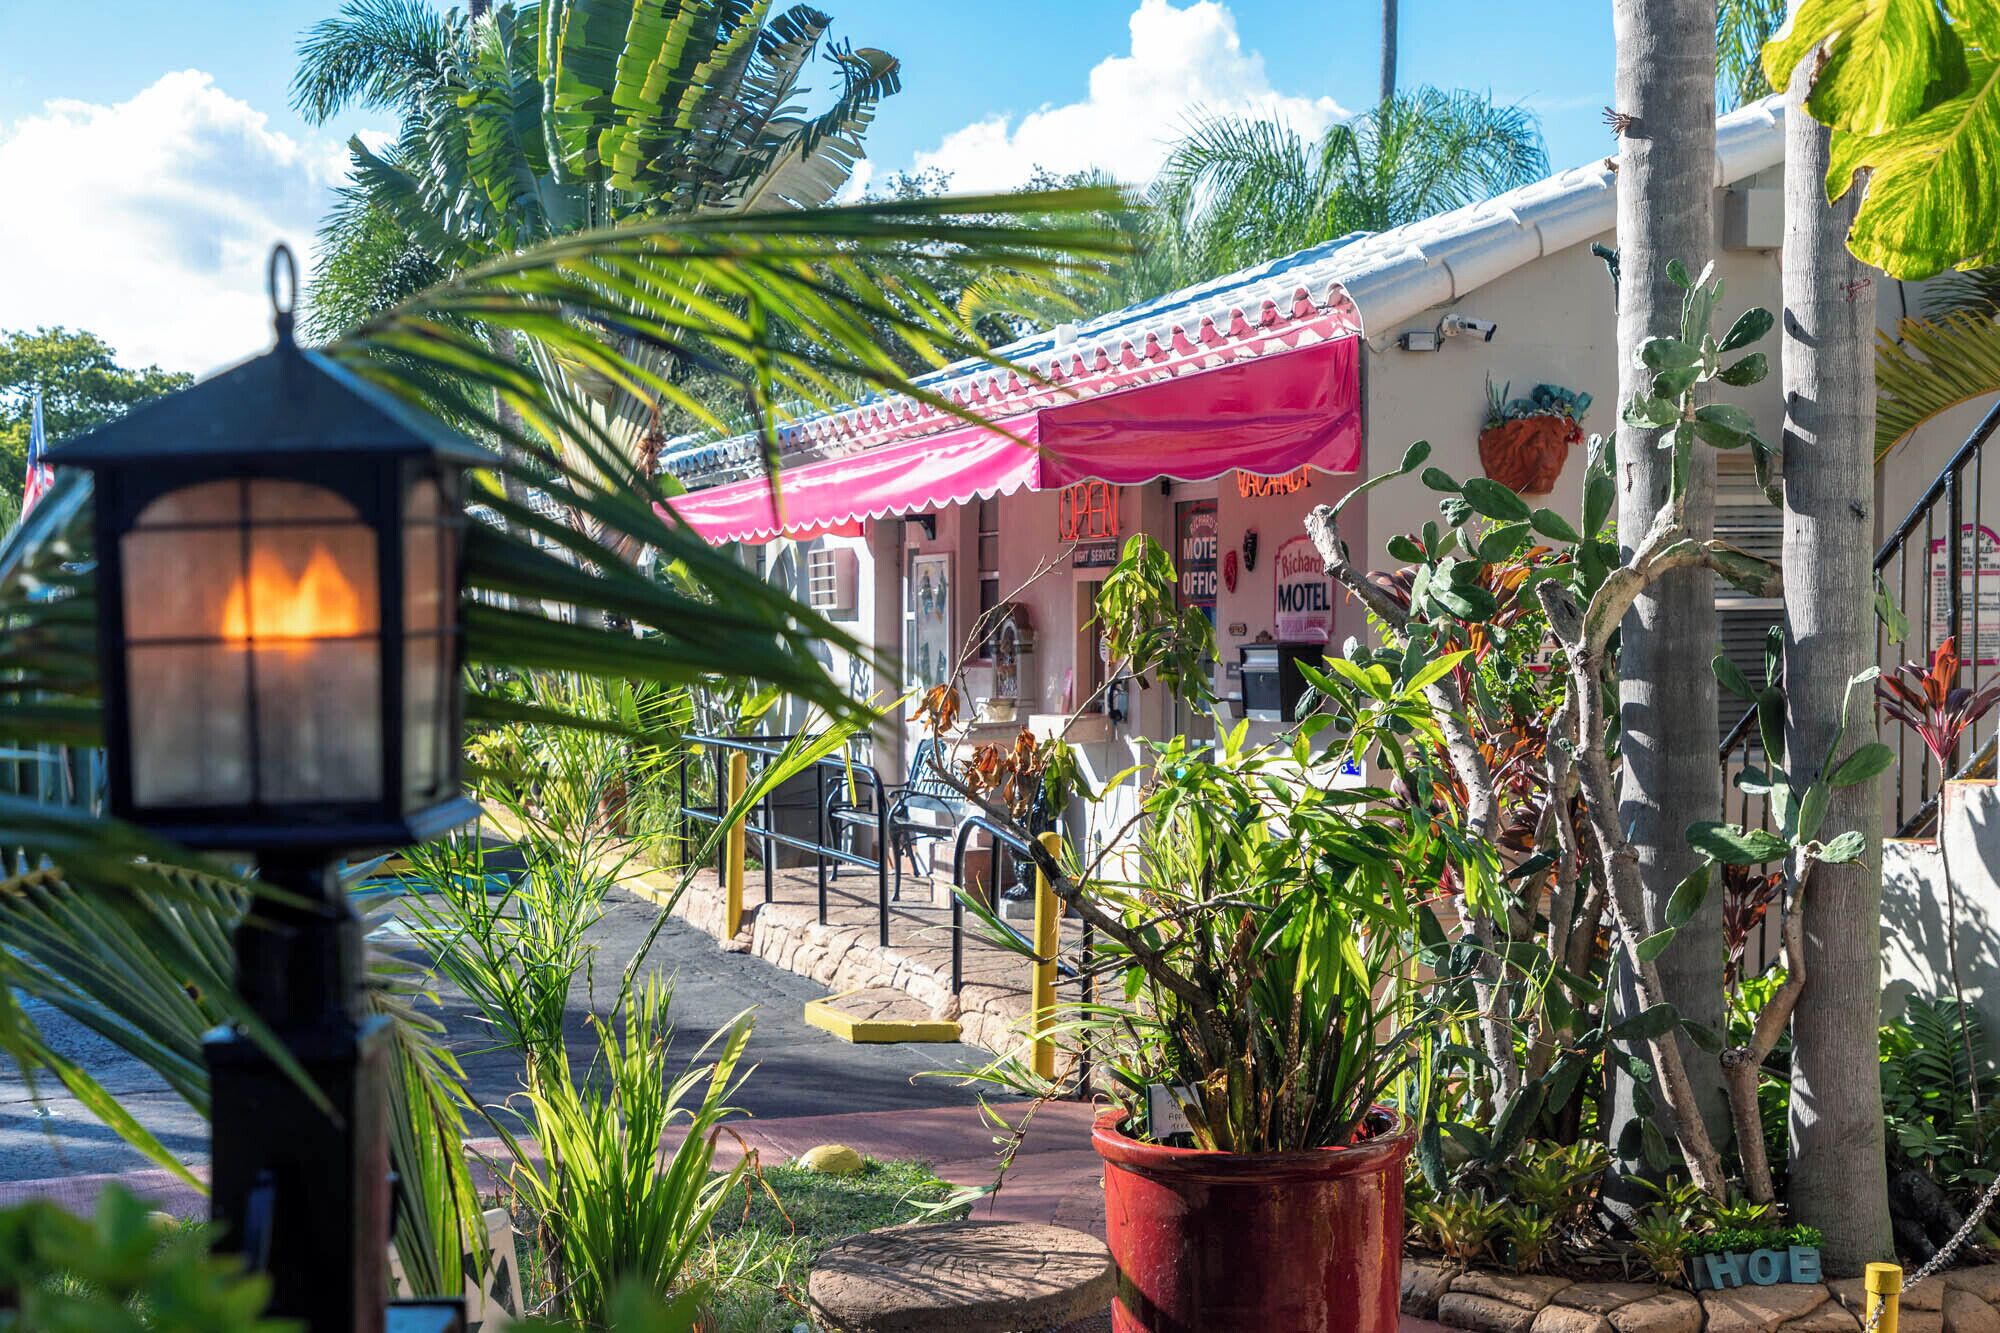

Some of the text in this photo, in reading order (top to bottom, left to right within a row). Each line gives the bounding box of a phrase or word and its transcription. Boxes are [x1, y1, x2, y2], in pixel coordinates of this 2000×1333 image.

[1060, 481, 1117, 539] OPEN
[1091, 548, 1116, 562] SERVICE
[1183, 536, 1217, 560] MOTE
[1183, 571, 1217, 595] OFFIC
[1278, 582, 1331, 612] MOTEL
